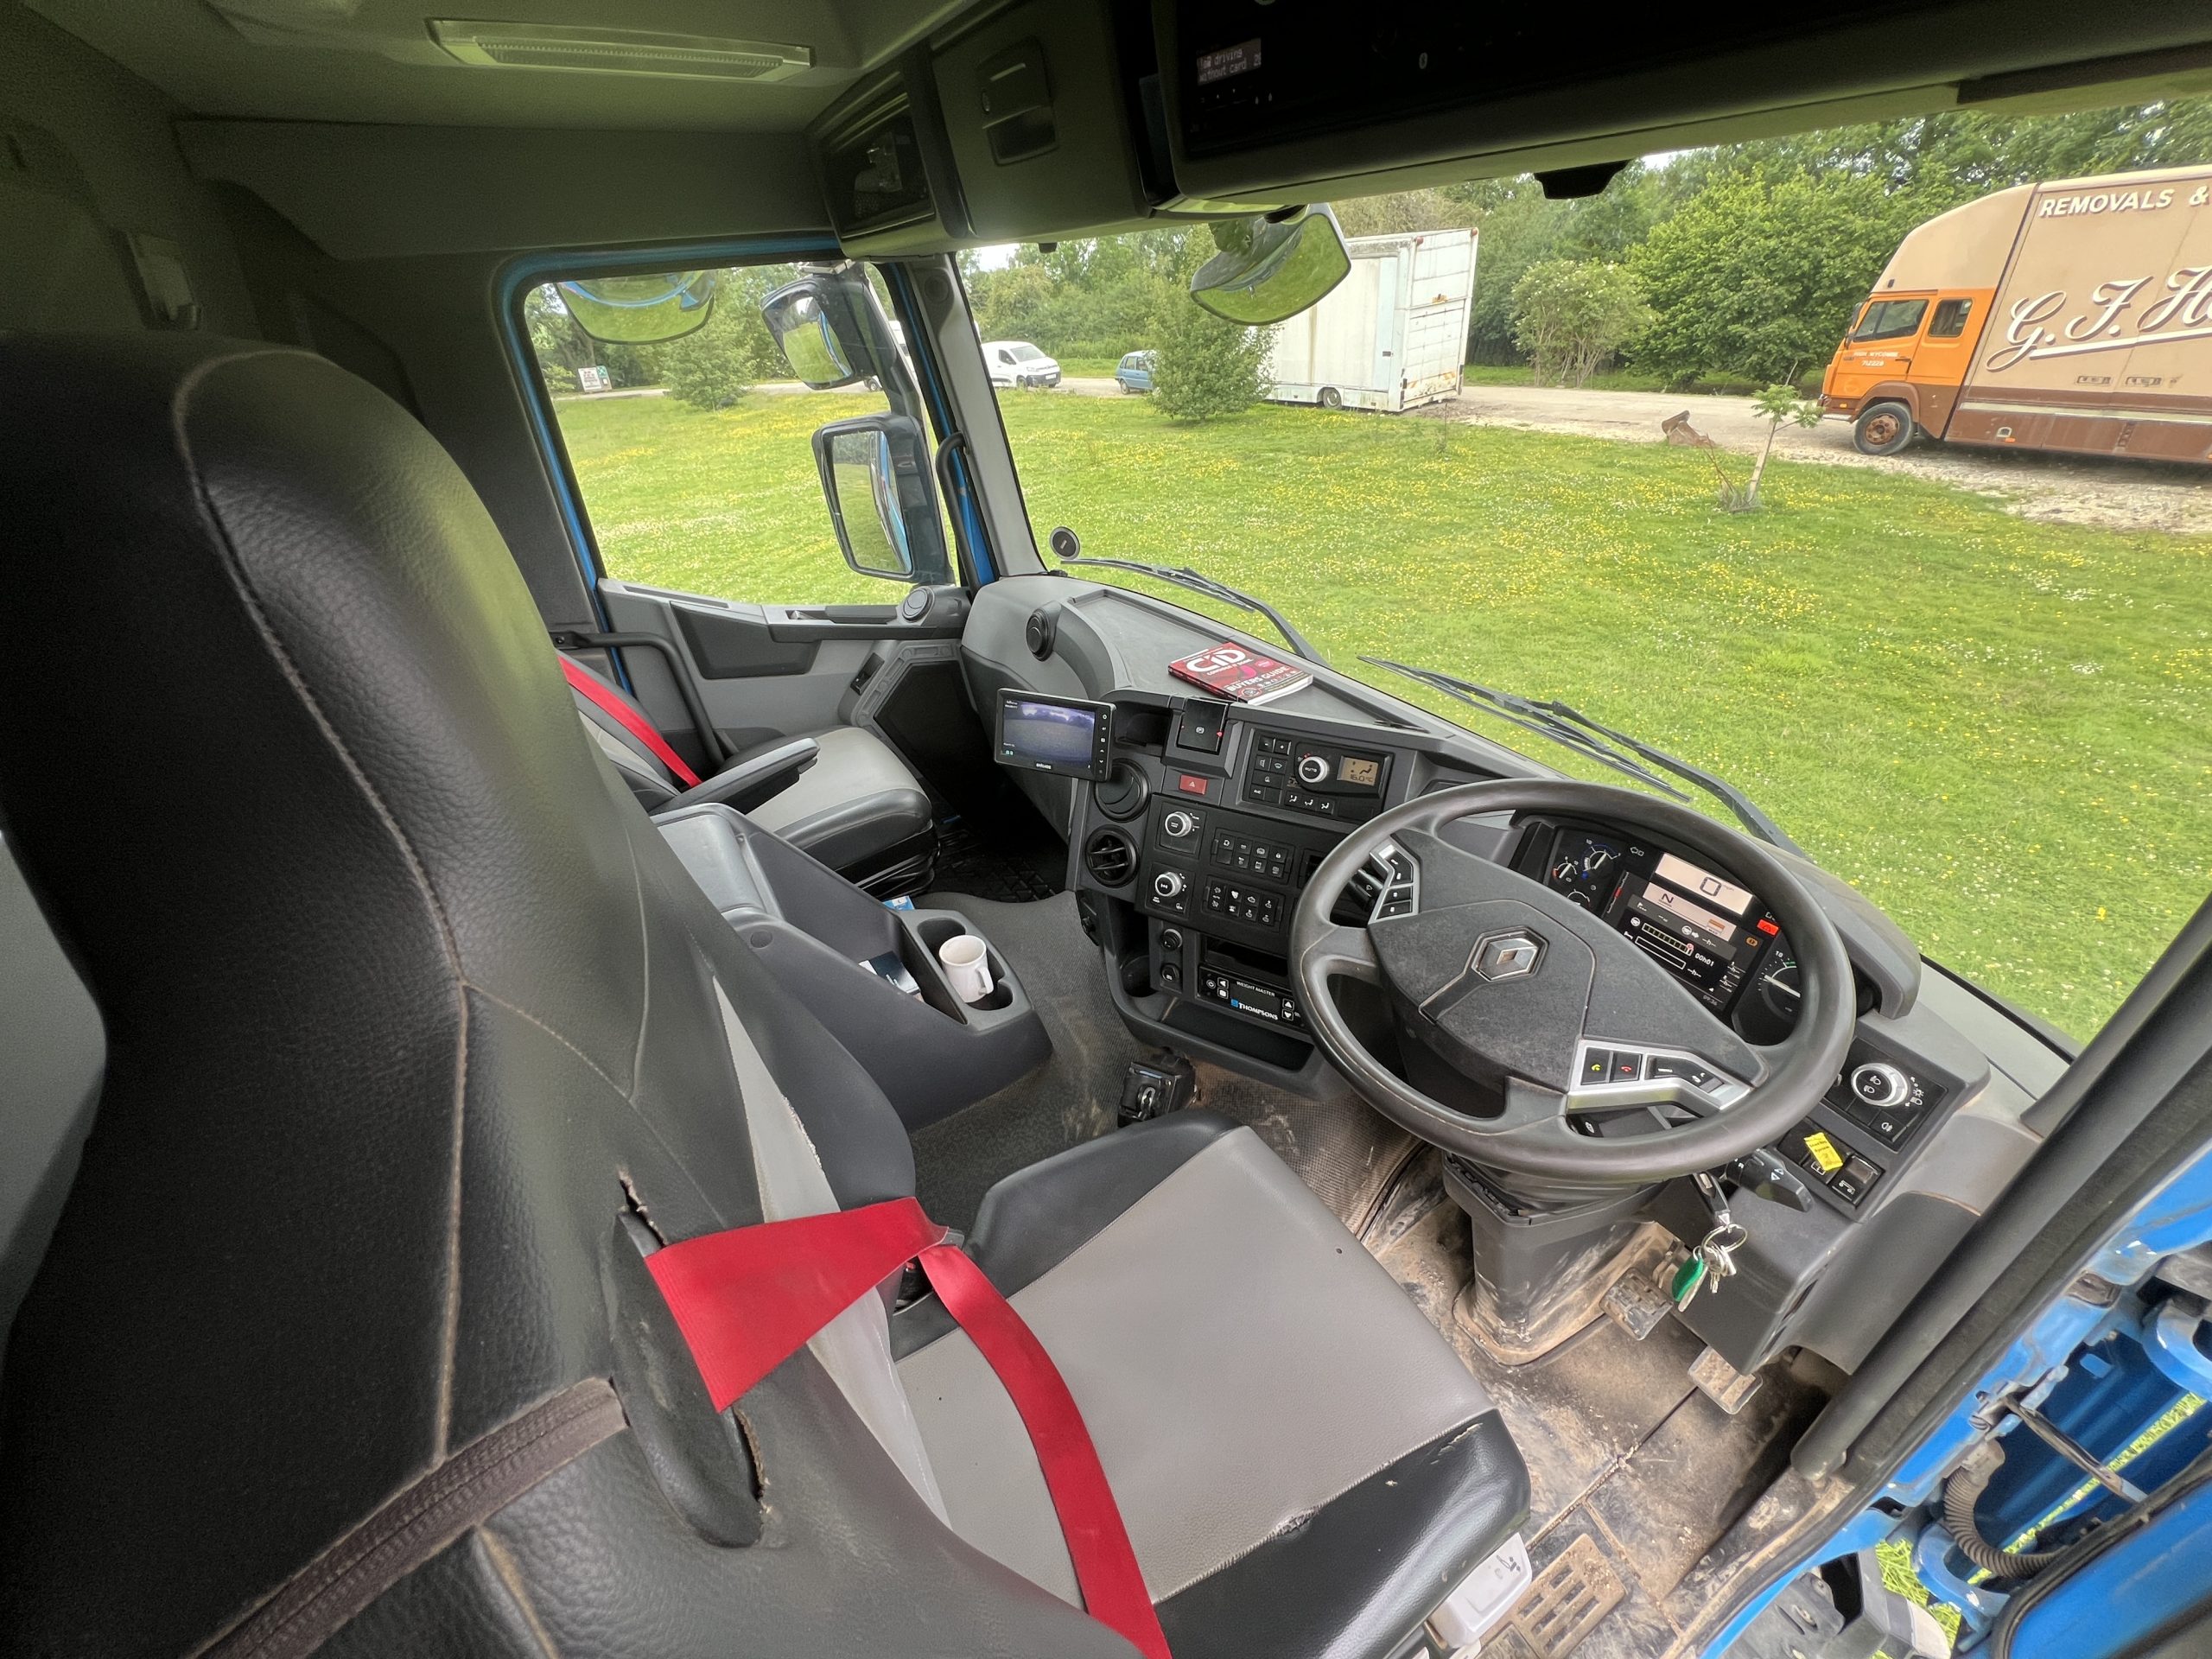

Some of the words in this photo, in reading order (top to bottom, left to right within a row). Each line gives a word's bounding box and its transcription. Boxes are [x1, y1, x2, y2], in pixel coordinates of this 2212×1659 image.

[1214, 48, 1243, 66] driving
[1230, 58, 1247, 73] card
[2039, 189, 2174, 217] REMOVALS
[2190, 186, 2209, 207] &
[1226, 676, 1263, 692] BUYERS
[1261, 666, 1291, 679] GUIDE
[1661, 893, 1675, 904] N
[1236, 981, 1255, 991] WEIGHT
[1255, 986, 1276, 997] MASTER
[1238, 1001, 1279, 1020] THOMPSONS
